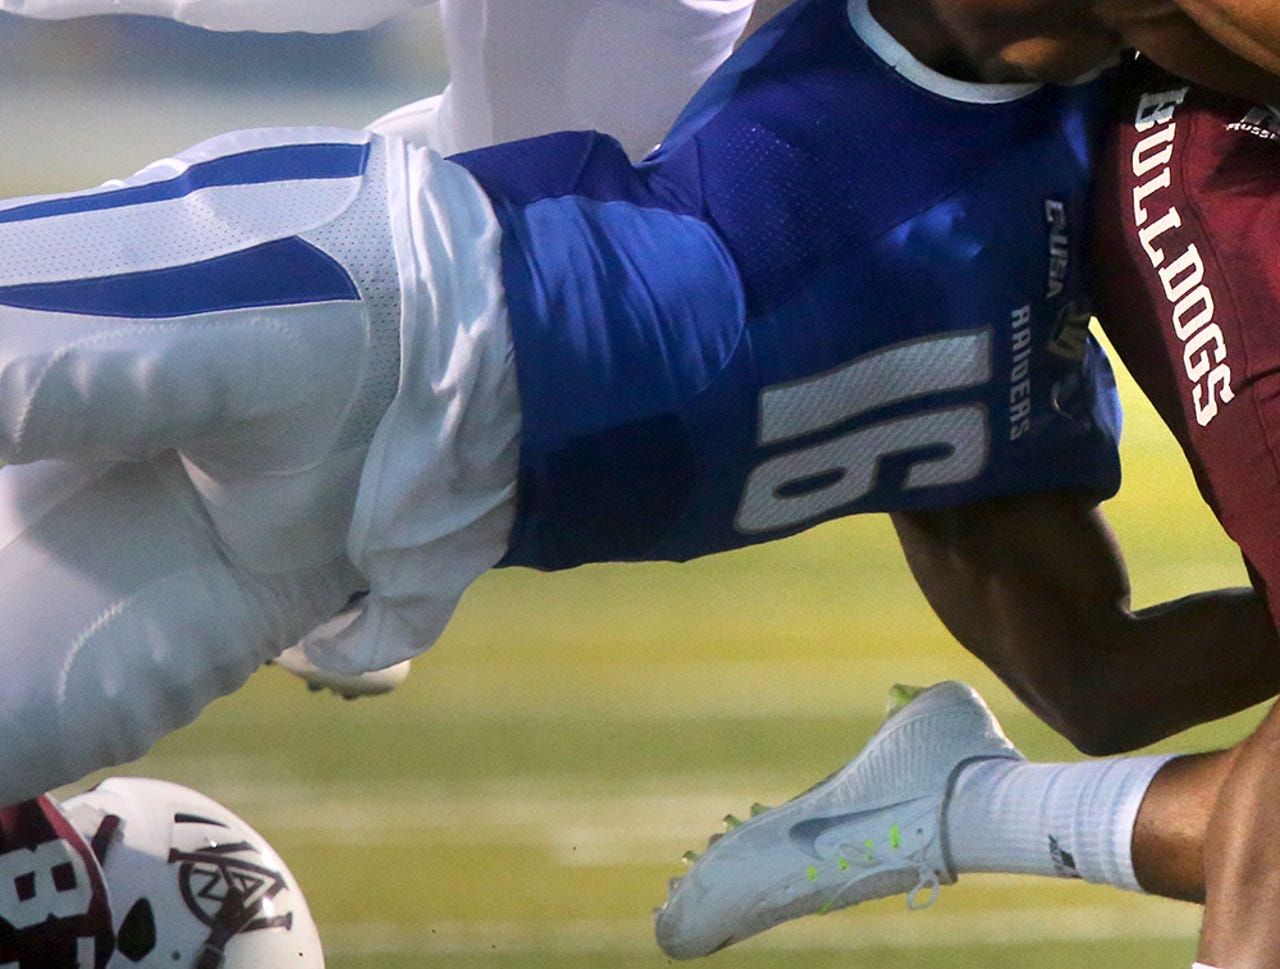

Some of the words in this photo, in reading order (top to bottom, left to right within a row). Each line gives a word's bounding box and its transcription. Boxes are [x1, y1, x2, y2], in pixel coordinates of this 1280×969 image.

[1131, 86, 1236, 427] BULLDOGS
[732, 324, 994, 533] 16
[1008, 303, 1033, 443] RAIDERS
